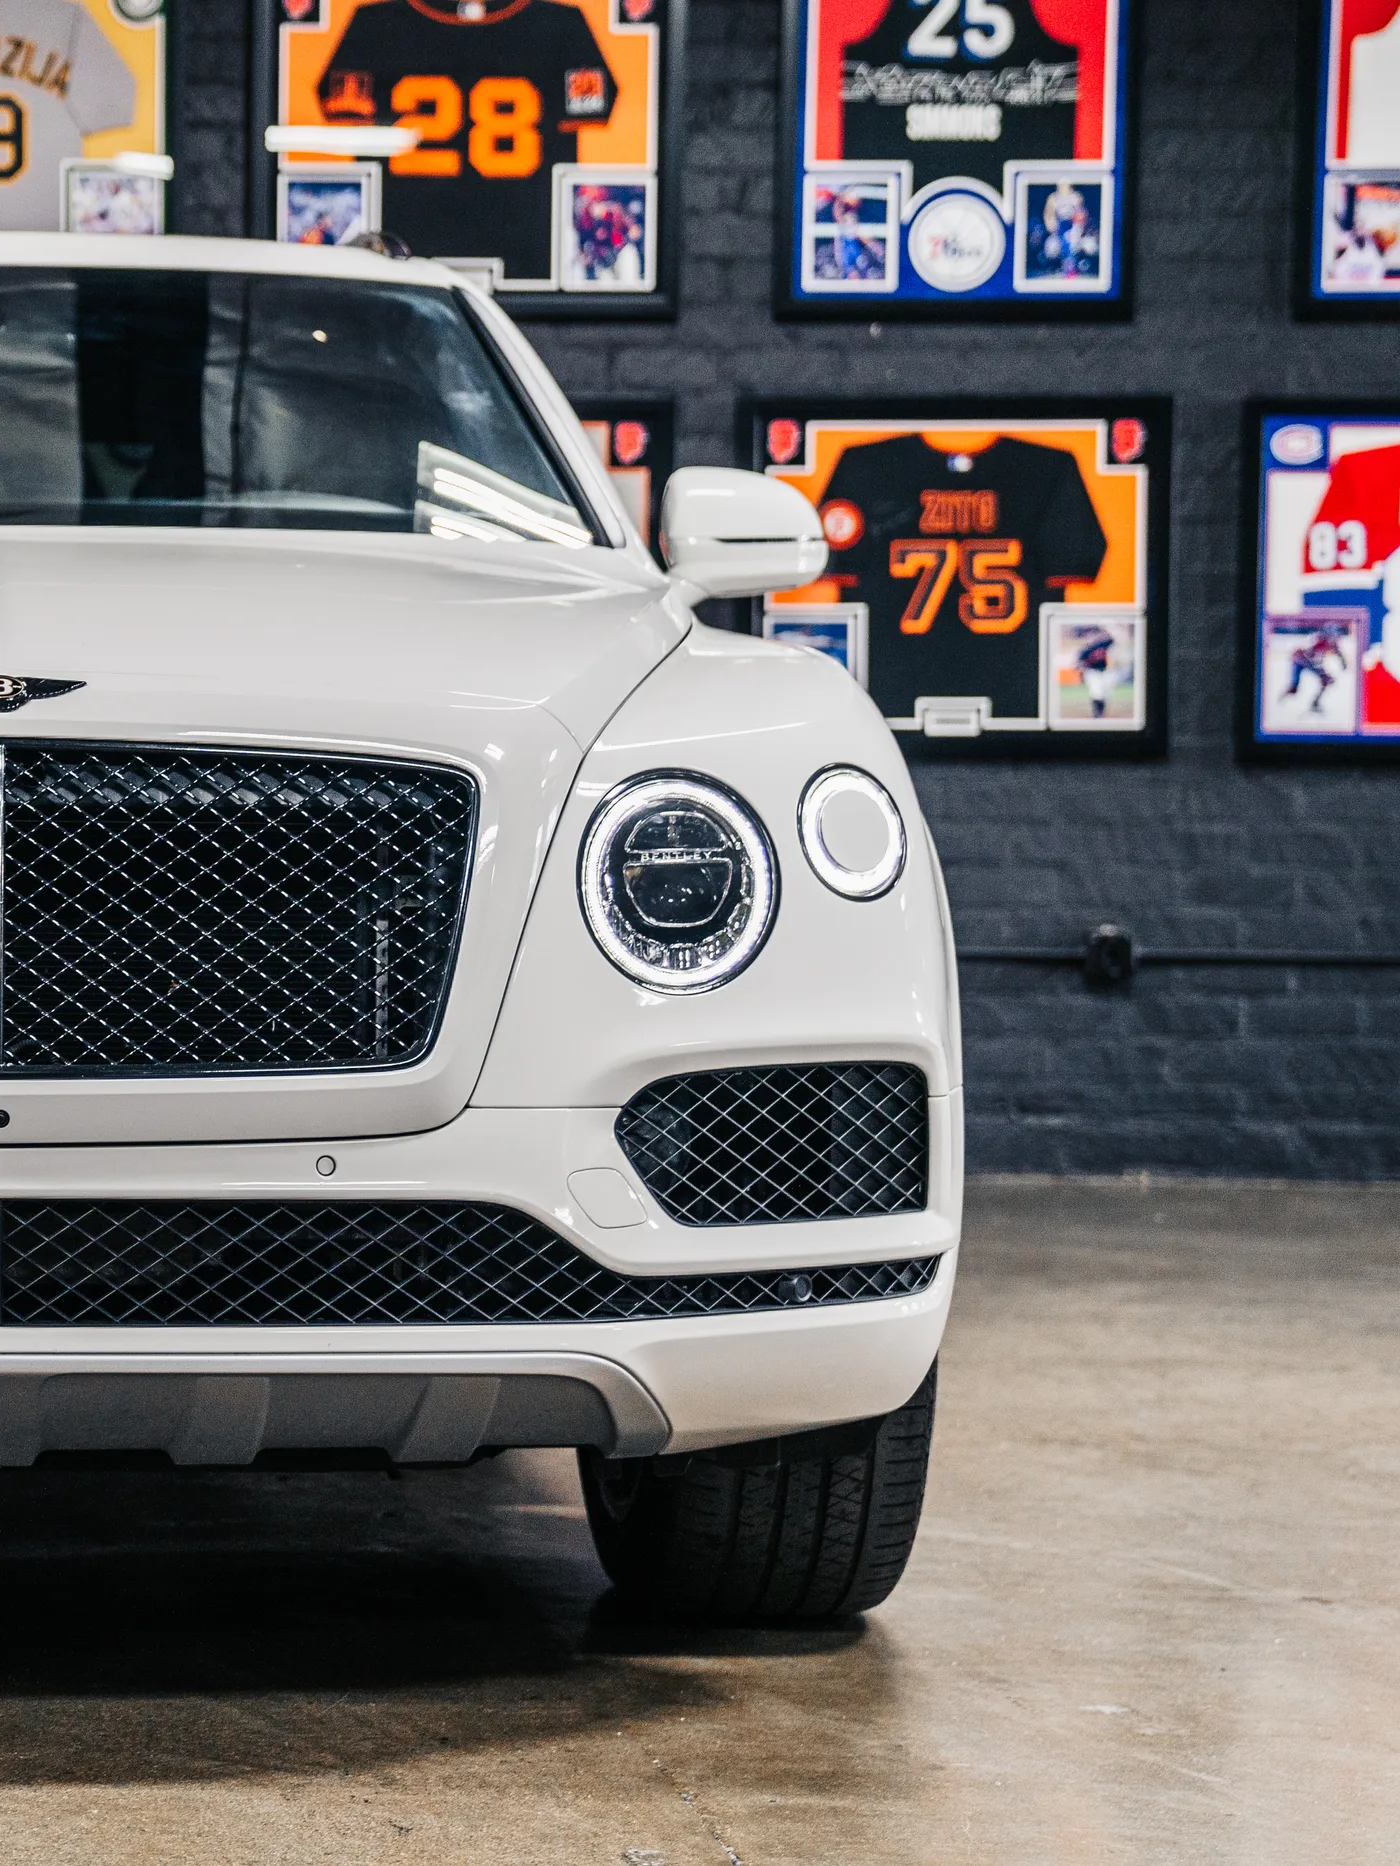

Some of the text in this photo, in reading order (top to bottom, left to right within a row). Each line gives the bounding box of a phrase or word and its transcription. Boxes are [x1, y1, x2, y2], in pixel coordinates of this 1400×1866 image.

[904, 0, 1016, 61] 25
[389, 74, 544, 179] 28
[1309, 520, 1368, 571] 83
[890, 539, 1029, 634] 75
[641, 850, 712, 862] BENTLEY
